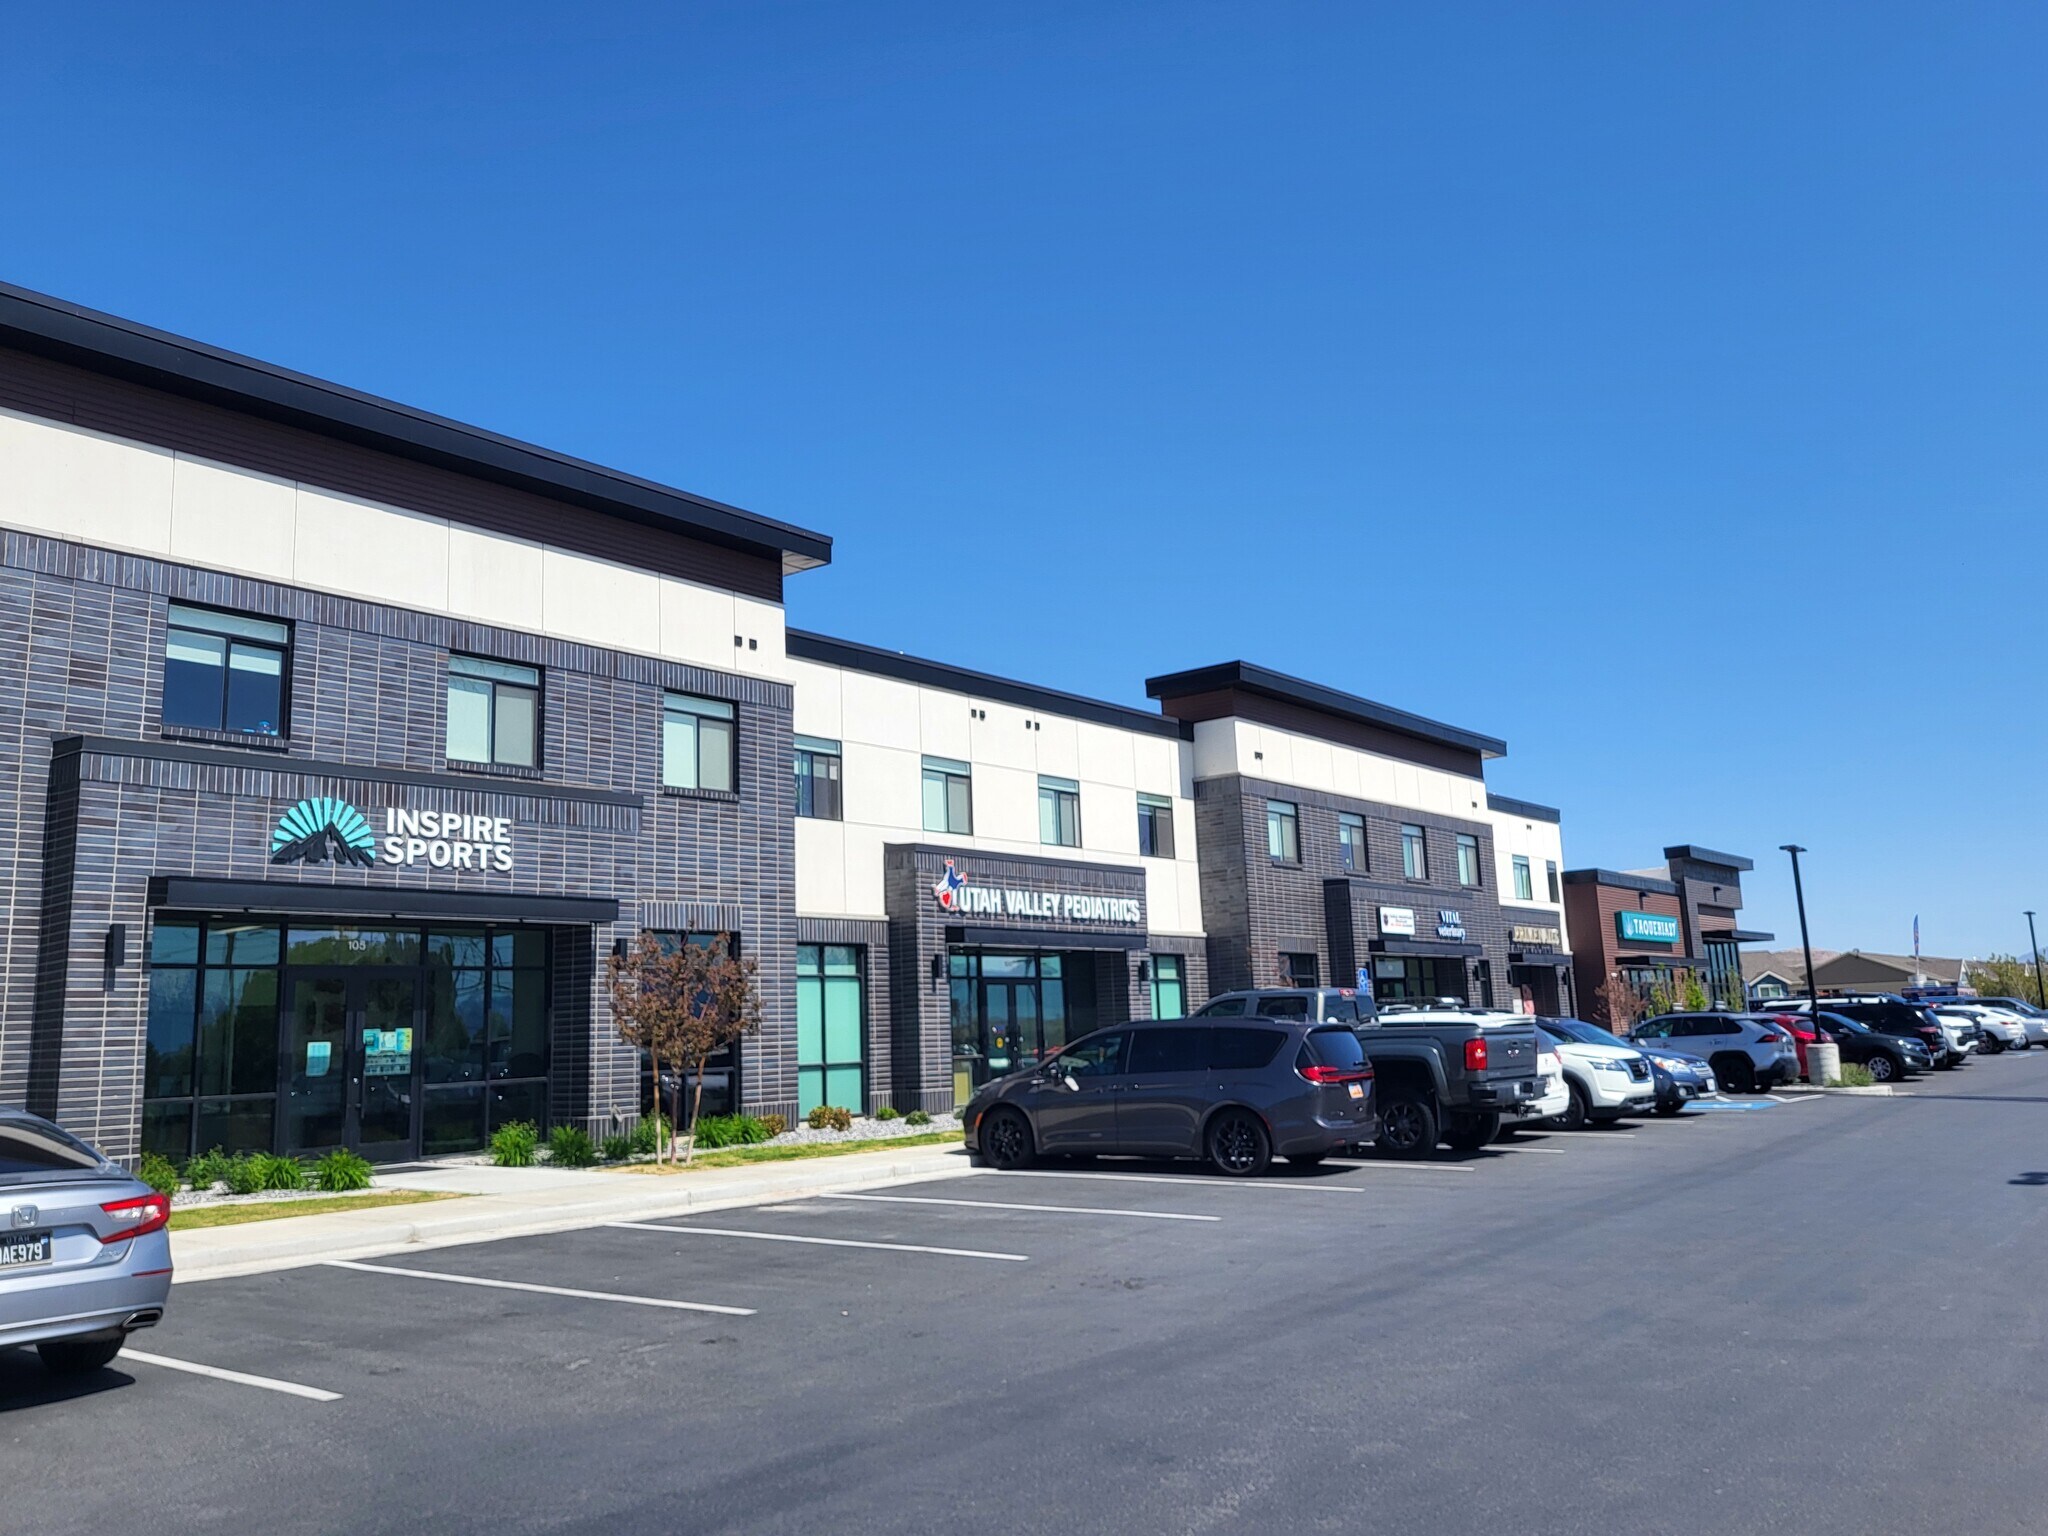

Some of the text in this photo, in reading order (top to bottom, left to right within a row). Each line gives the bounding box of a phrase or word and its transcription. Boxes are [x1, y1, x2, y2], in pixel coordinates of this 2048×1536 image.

[386, 807, 512, 843] INSPIRE
[382, 836, 513, 871] SPORTS
[960, 886, 1141, 922] UTAH VALLEY PEDIATRICS
[1440, 910, 1461, 924] VITAL
[348, 940, 366, 951] 105
[6, 1233, 30, 1244] UTAH
